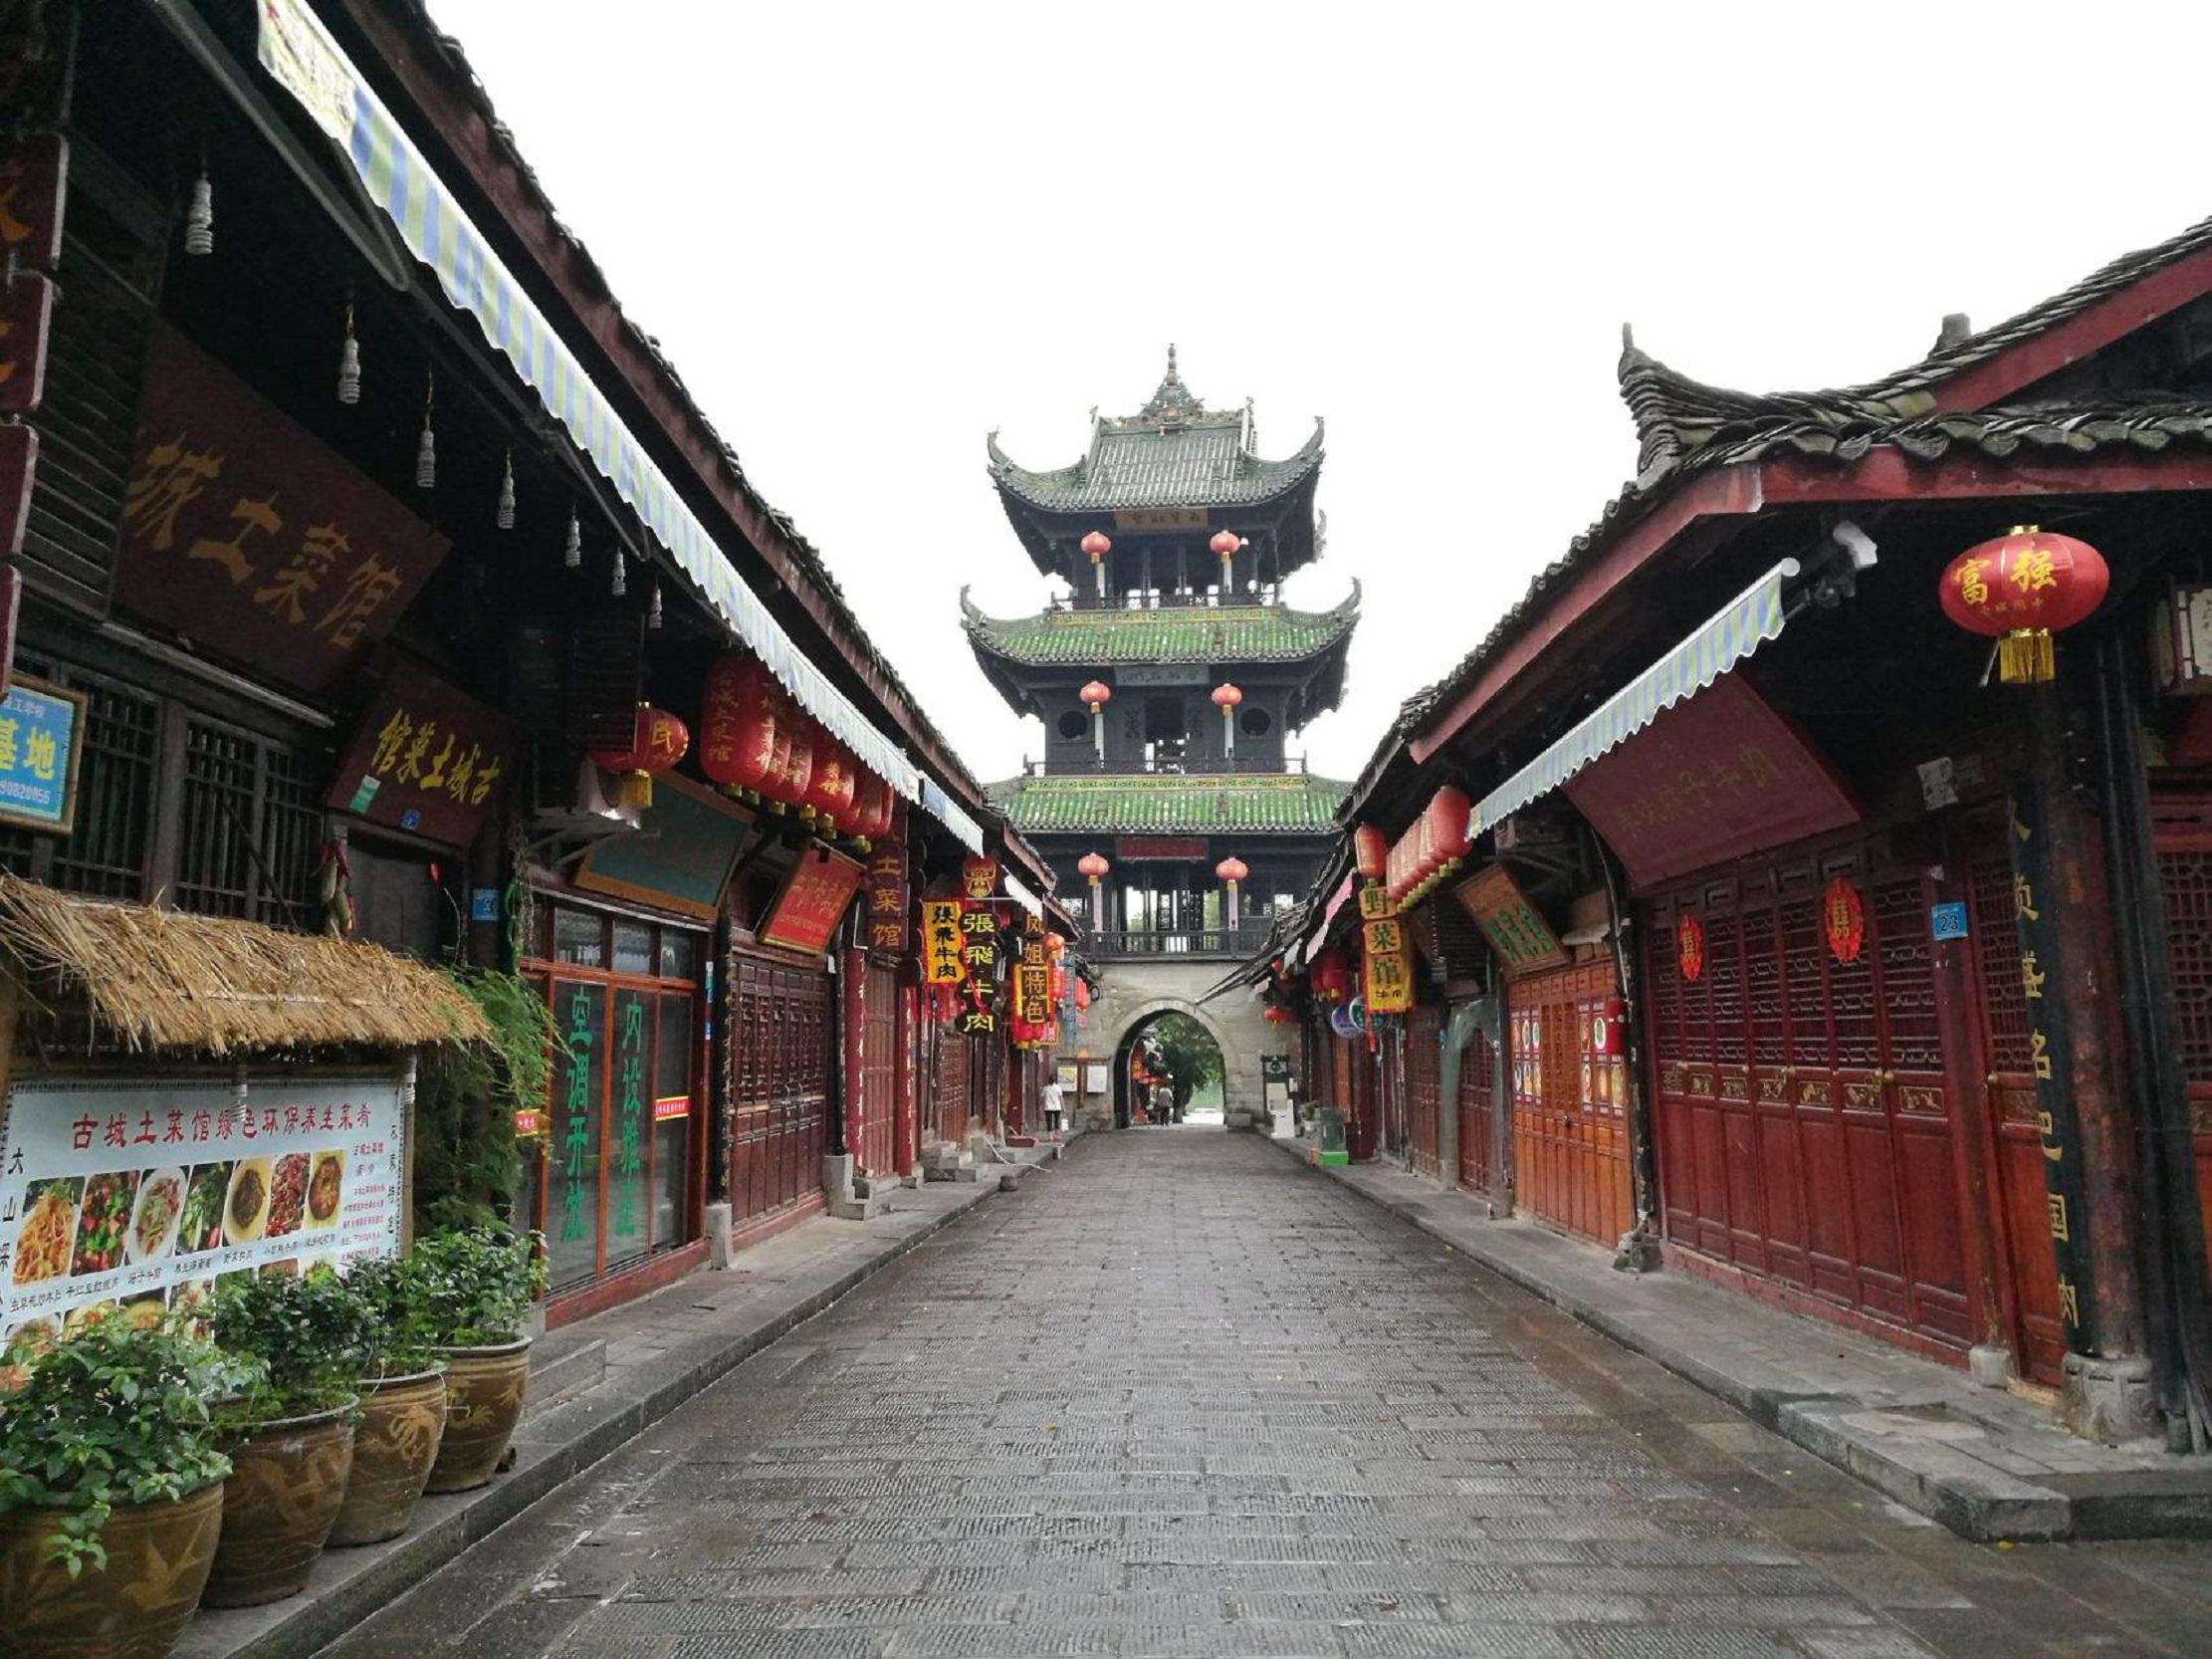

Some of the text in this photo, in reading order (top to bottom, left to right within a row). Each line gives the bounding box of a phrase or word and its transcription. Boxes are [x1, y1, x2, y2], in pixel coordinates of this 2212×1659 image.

[1954, 550, 2058, 604] 富强
[652, 719, 675, 755] 民
[1940, 913, 1959, 932] 23
[963, 913, 995, 1033] 張飛牛肉
